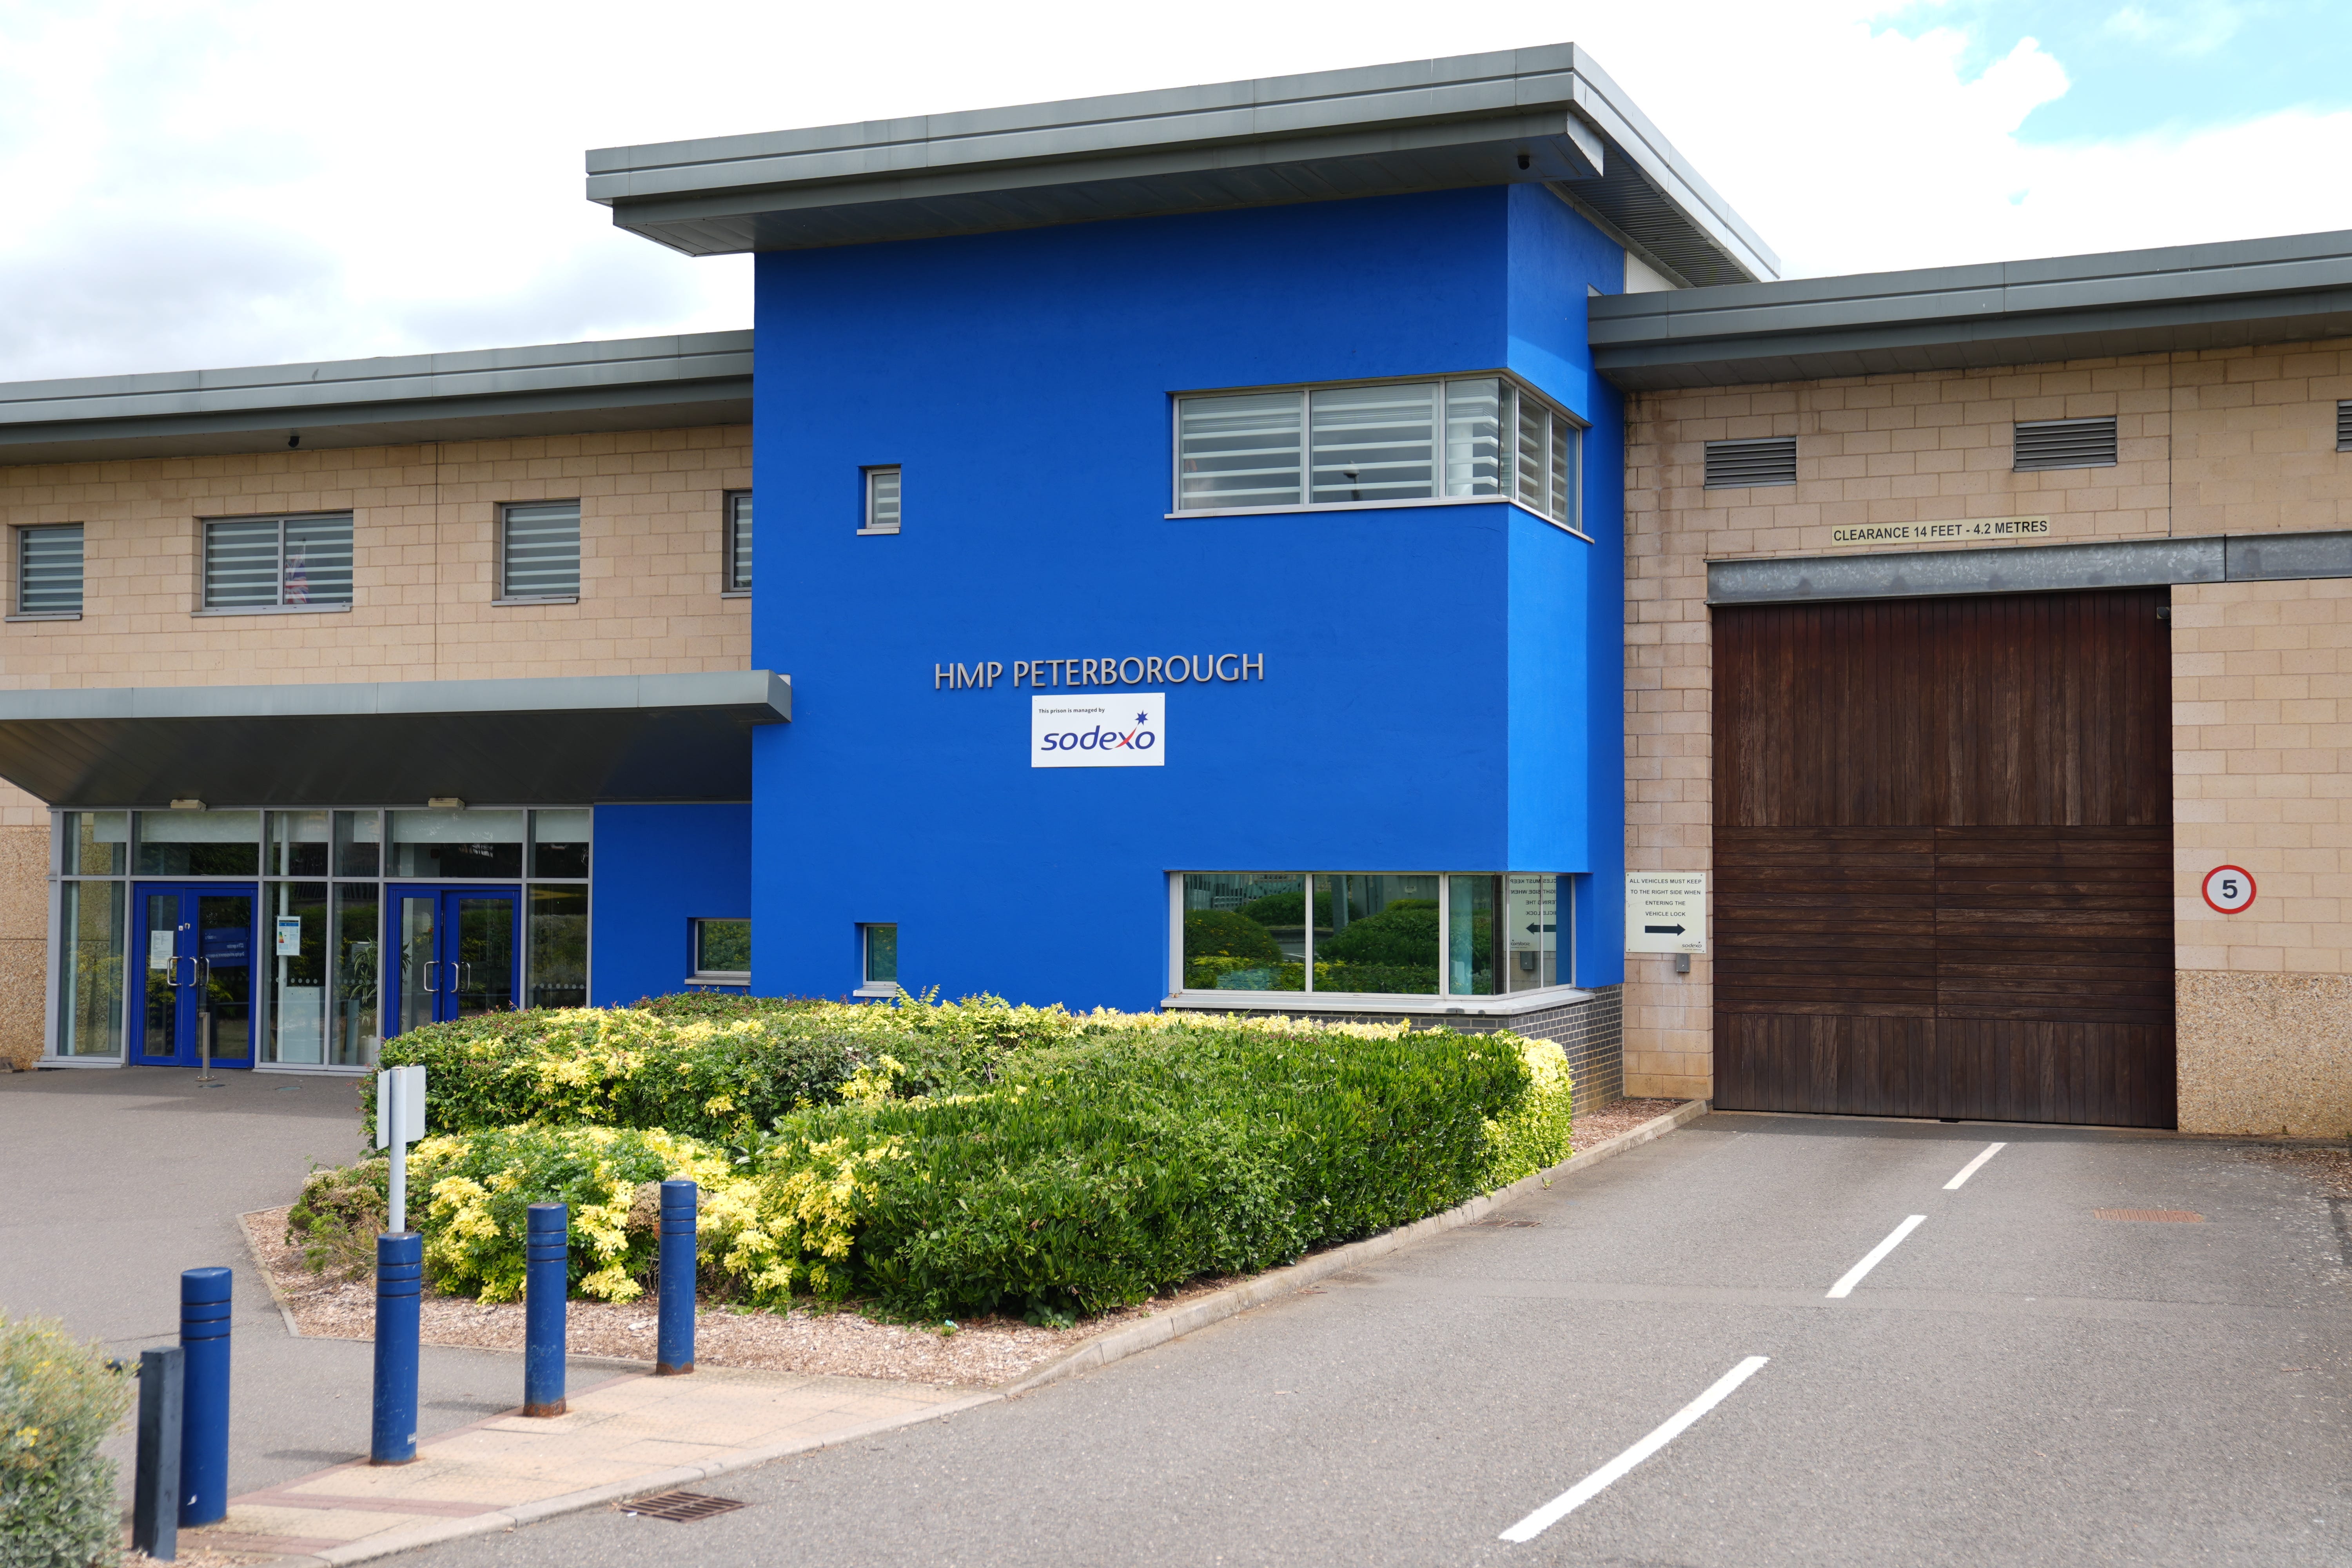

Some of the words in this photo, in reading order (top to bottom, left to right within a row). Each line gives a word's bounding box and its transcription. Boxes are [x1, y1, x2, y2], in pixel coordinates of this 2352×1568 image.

[1833, 526, 1909, 541] CLEARANCE
[1914, 526, 1927, 537] 14
[1931, 524, 1962, 537] FEET
[1973, 523, 1991, 534] 4.2
[1995, 521, 2047, 534] METRES
[935, 661, 1003, 689] HMP
[1014, 653, 1264, 687] PETERBOROUGH
[1041, 725, 1155, 751] sodexo
[2222, 879, 2238, 899] 5
